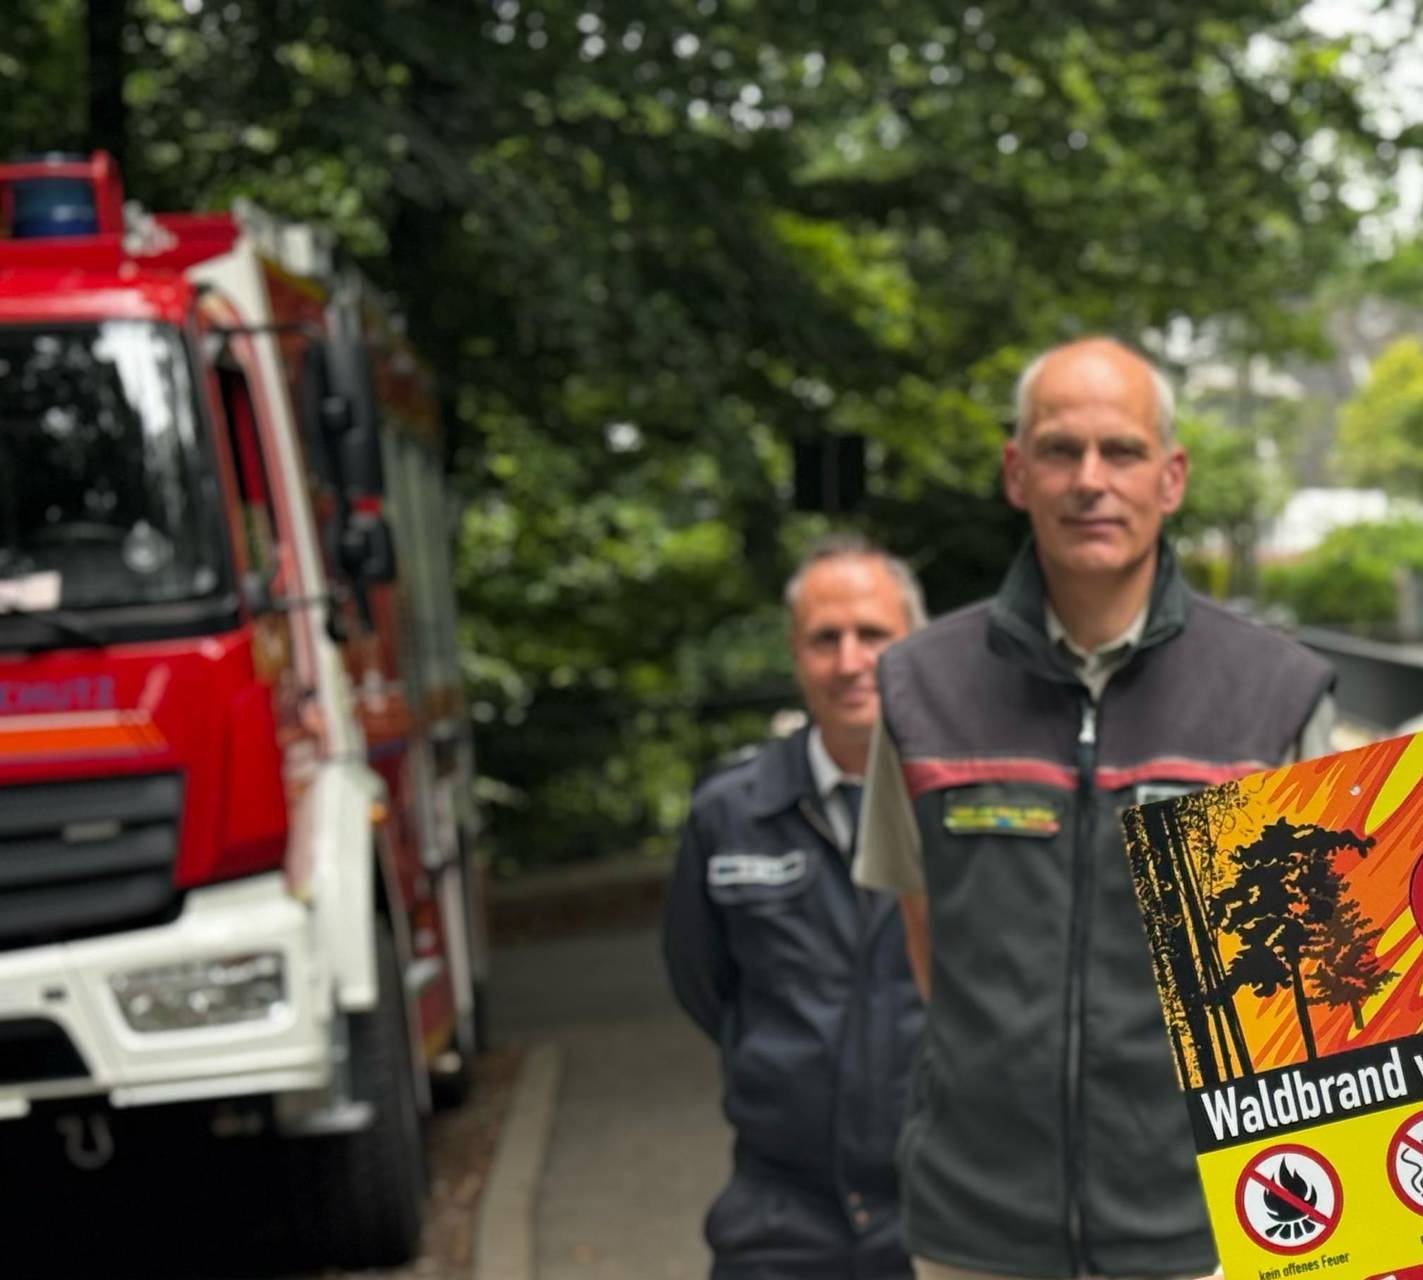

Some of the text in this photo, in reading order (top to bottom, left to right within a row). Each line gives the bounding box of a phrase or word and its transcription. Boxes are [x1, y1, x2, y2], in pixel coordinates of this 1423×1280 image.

[1201, 1047, 1408, 1141] Waldbrand
[1258, 1252, 1350, 1280] kein offenes Feuer
